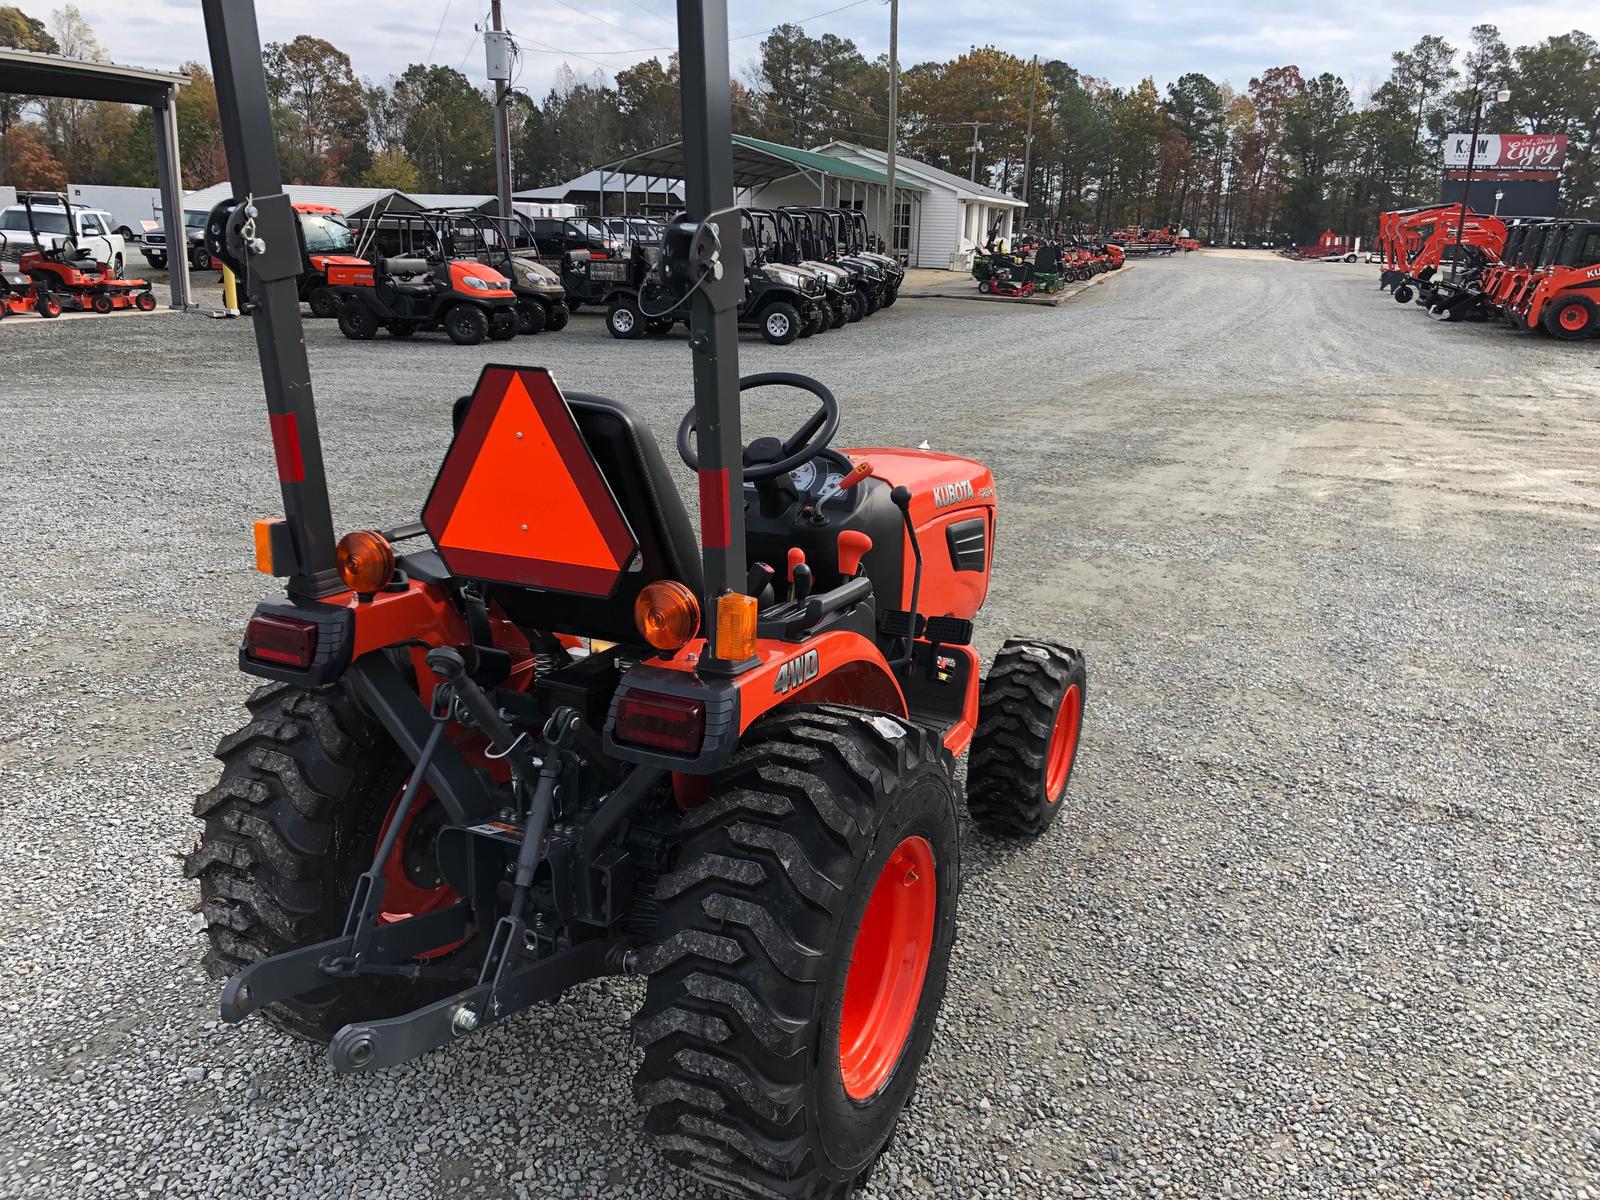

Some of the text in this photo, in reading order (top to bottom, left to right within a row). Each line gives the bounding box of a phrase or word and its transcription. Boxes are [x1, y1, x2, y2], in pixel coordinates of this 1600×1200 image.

[1507, 141, 1559, 166] Enjoy
[933, 479, 975, 509] KUBOTA
[773, 648, 819, 696] 4WD
